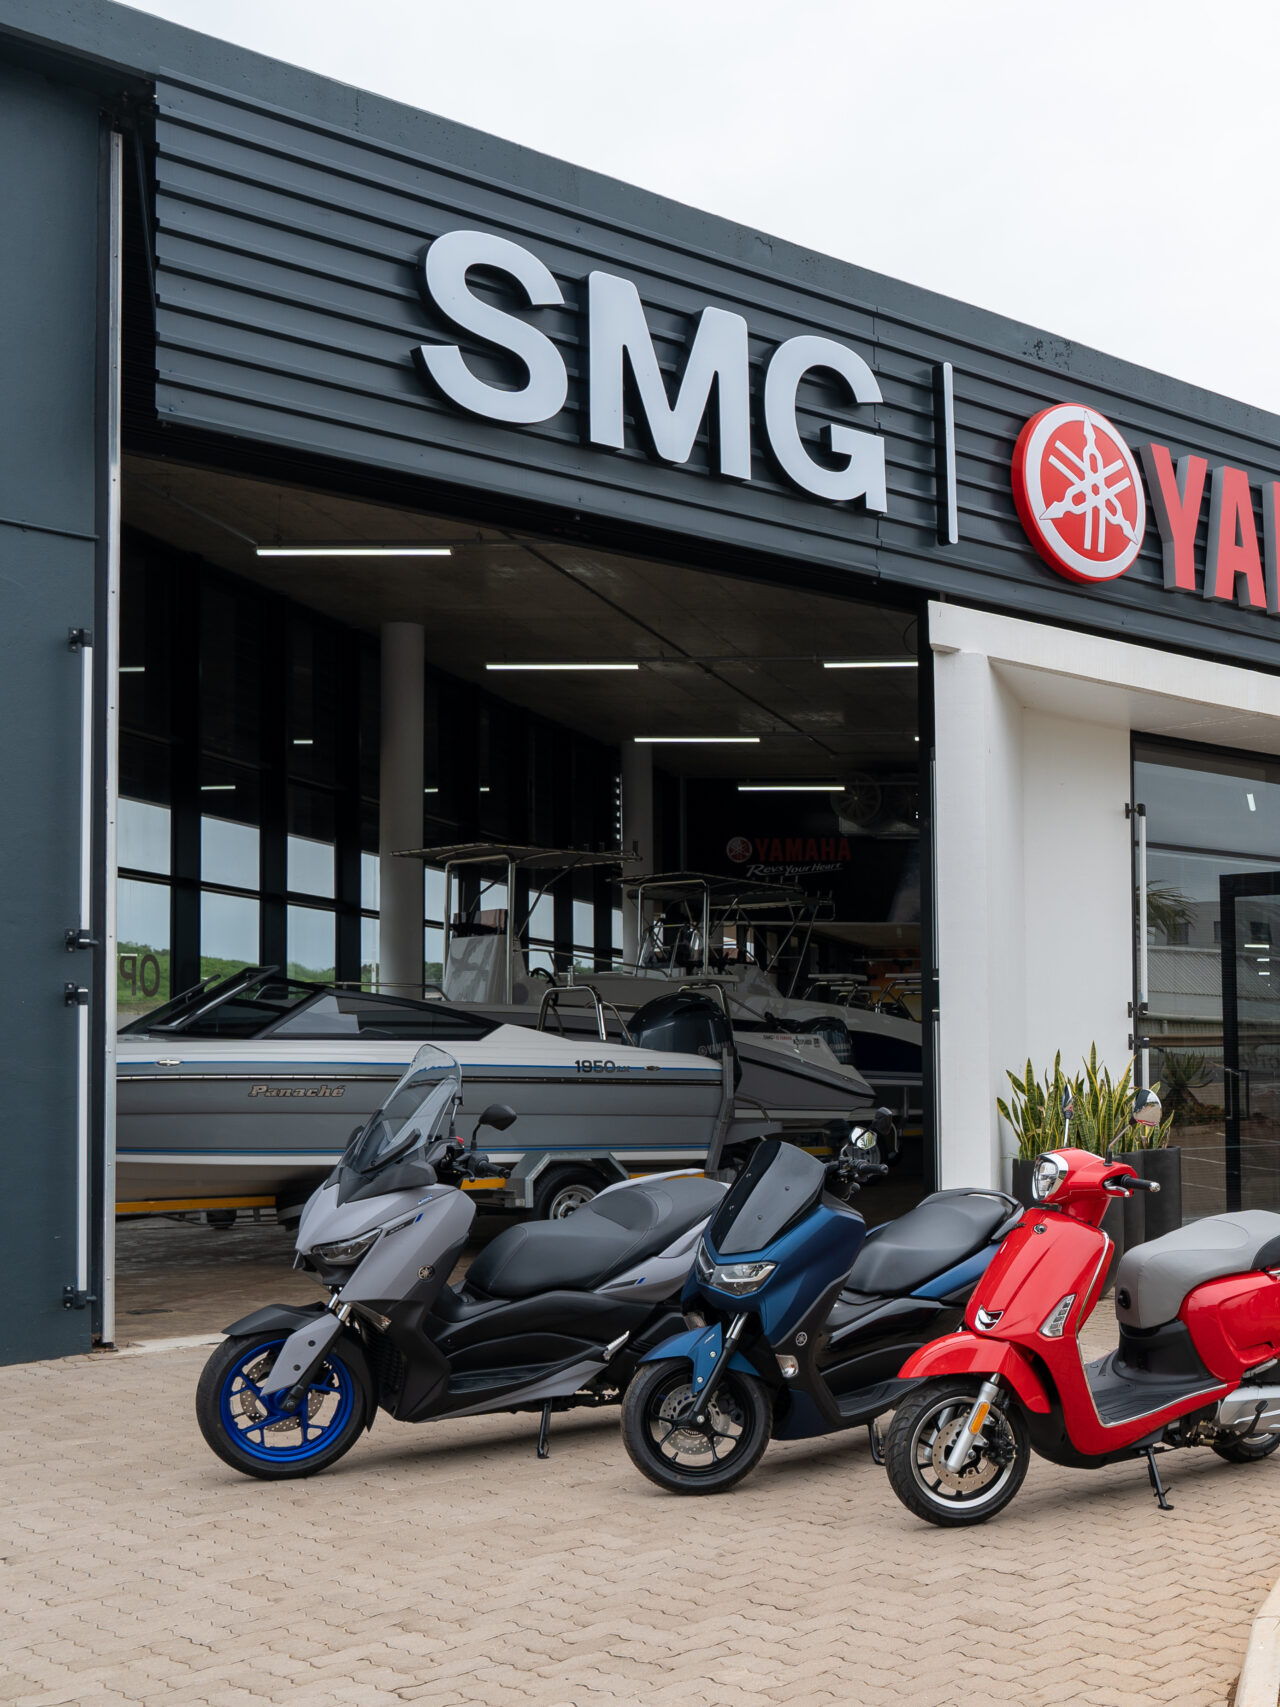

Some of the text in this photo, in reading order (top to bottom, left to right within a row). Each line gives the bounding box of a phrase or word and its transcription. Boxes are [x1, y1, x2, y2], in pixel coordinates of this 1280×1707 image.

[412, 230, 887, 513] SMG
[754, 838, 852, 862] YAMAHA
[575, 1059, 616, 1074] 1950
[247, 1084, 346, 1098] Panaché
